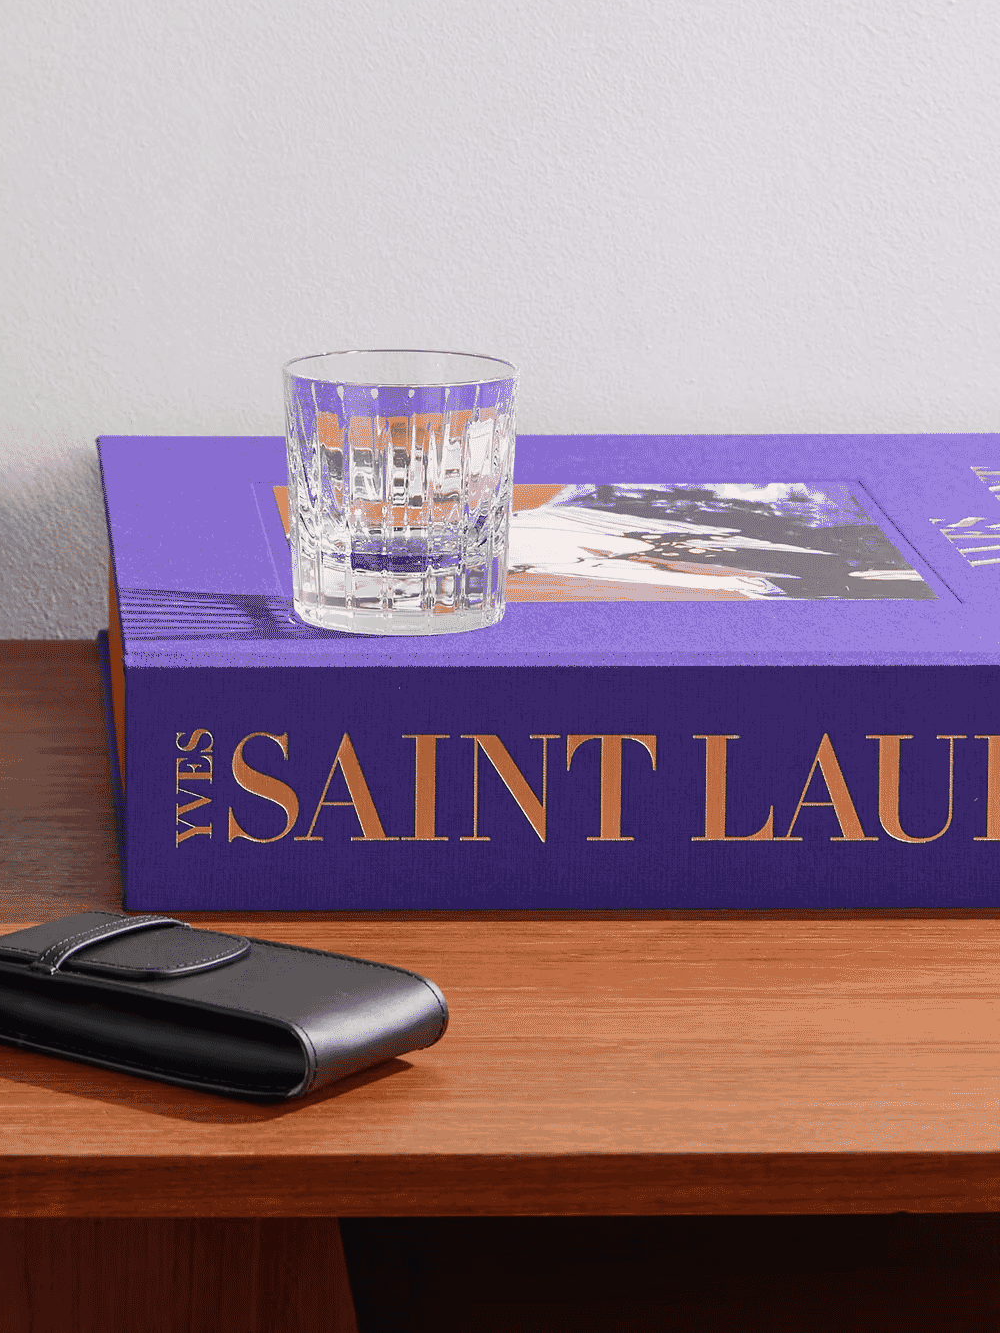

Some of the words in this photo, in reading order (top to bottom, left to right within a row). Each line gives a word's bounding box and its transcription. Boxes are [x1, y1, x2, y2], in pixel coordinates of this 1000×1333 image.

[175, 727, 214, 848] YVES
[228, 731, 657, 843] SAINT
[691, 732, 1000, 843] LAU
